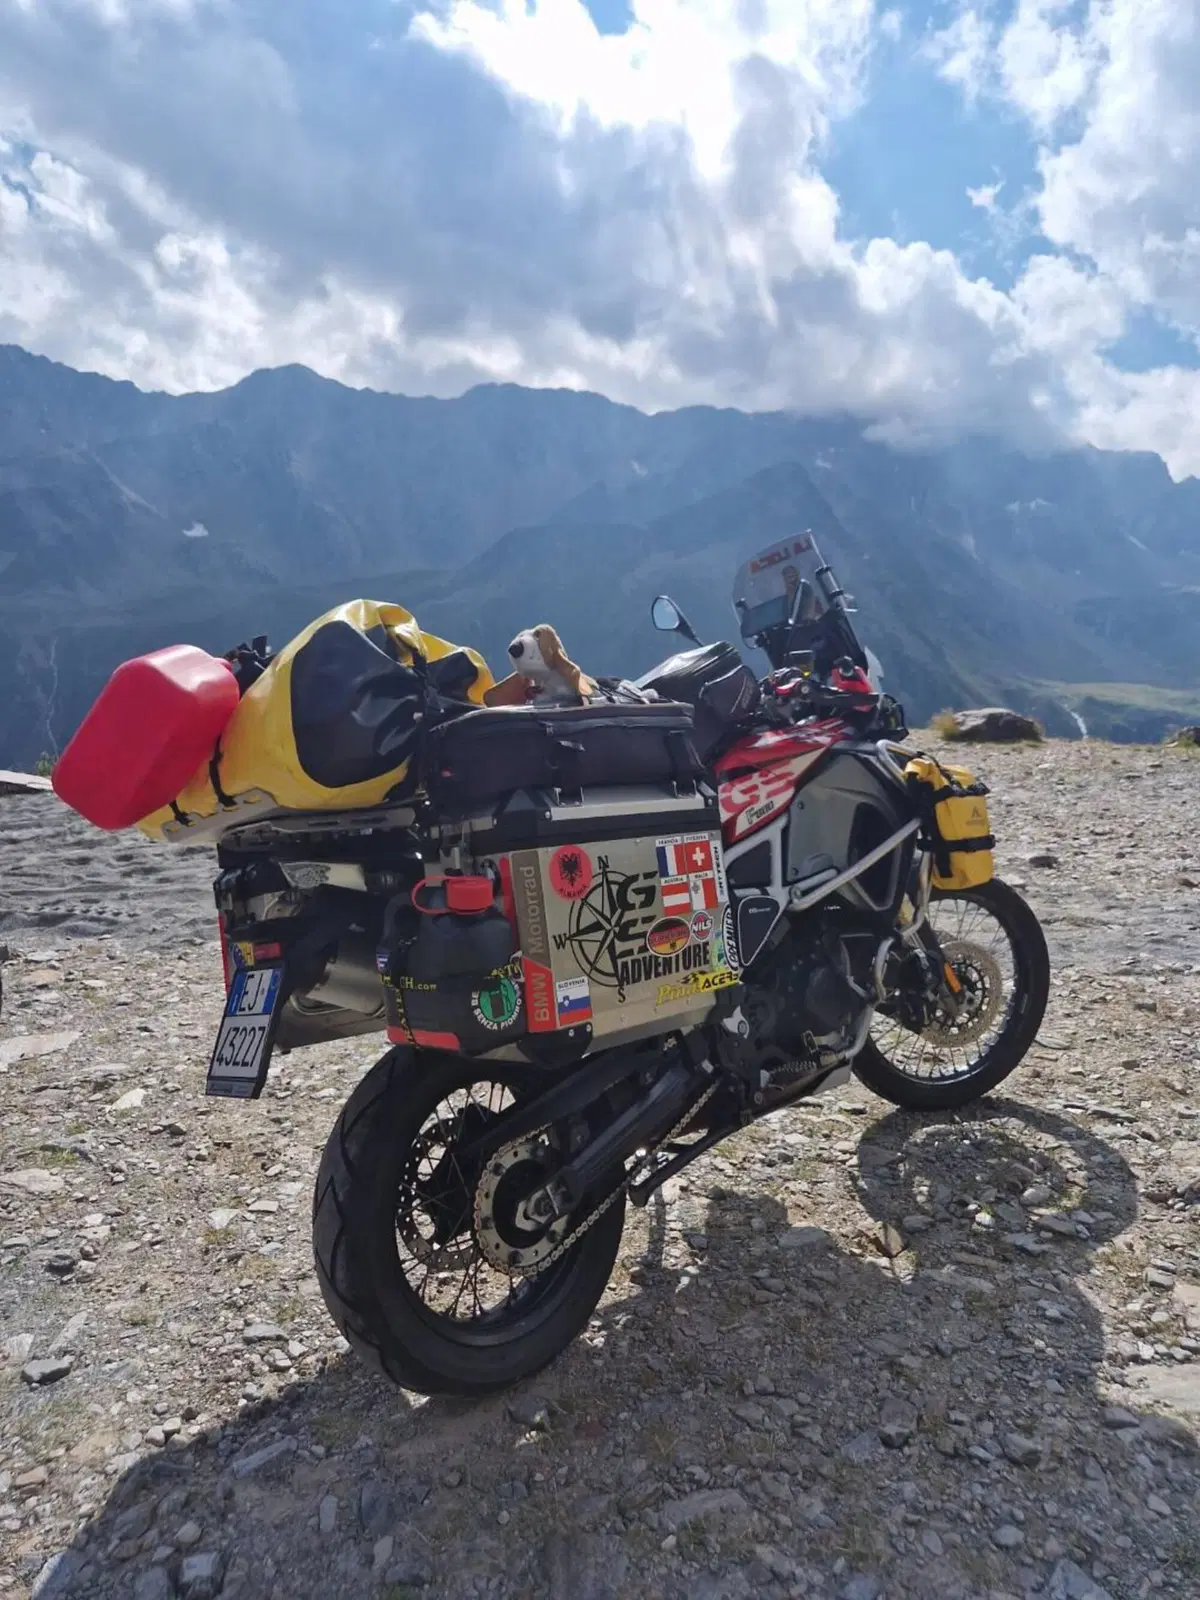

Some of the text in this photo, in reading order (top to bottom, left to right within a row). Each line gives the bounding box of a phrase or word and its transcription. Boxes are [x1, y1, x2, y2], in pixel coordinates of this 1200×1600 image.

[720, 759, 796, 814] GS
[520, 866, 550, 1022] BMW Motorrad
[691, 917, 713, 932] NILS
[619, 941, 710, 987] ADVENTURE
[239, 973, 263, 1011] EJ
[474, 998, 522, 1031] SENZA PIOMBO
[216, 1026, 267, 1067] 43227
